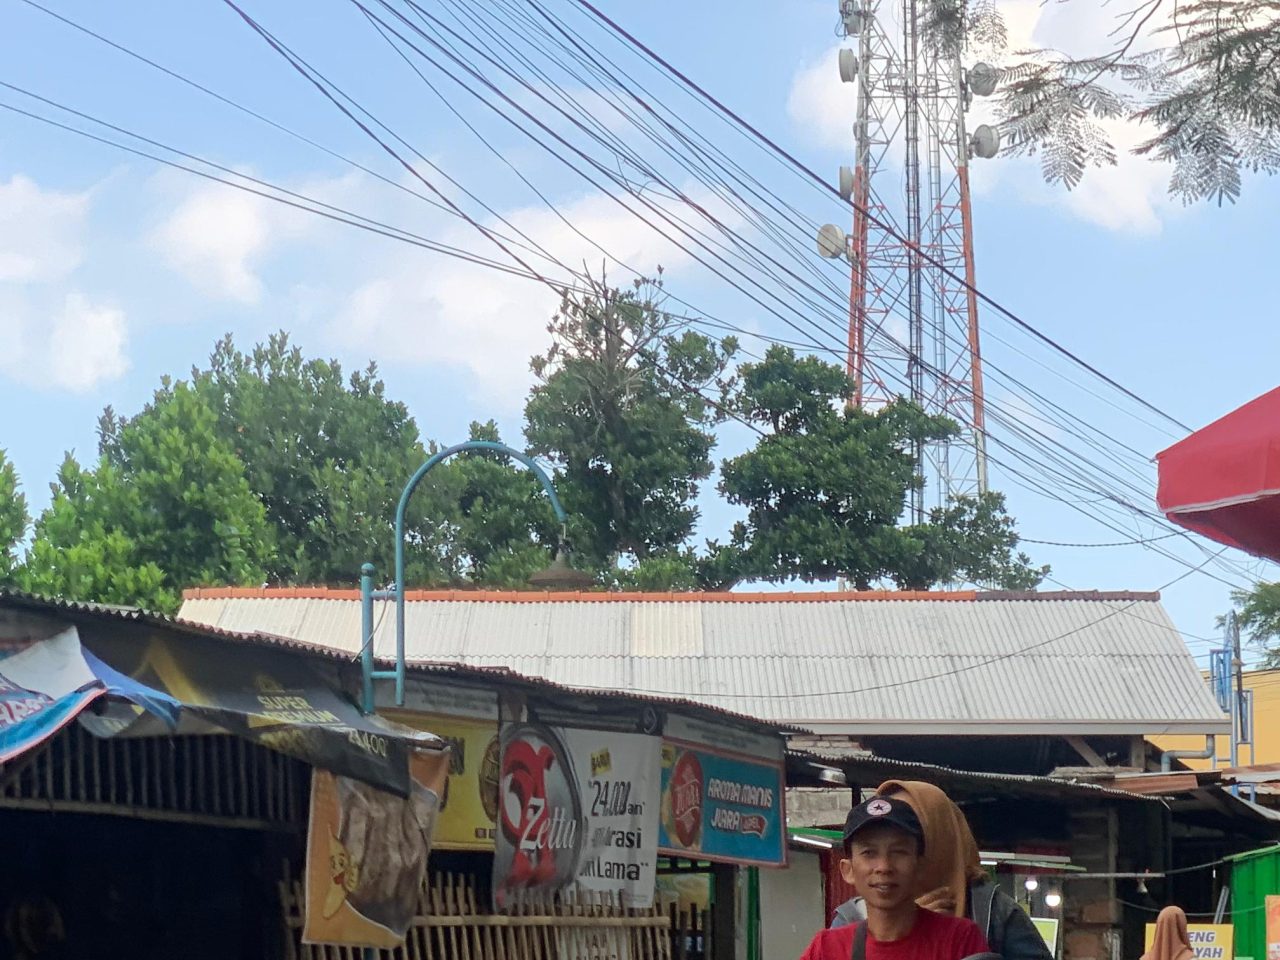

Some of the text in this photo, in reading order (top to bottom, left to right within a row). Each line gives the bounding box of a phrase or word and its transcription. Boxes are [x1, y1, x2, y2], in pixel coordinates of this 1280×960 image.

[708, 778, 773, 809] AROMA MANIS
[519, 796, 577, 850] Zetta
